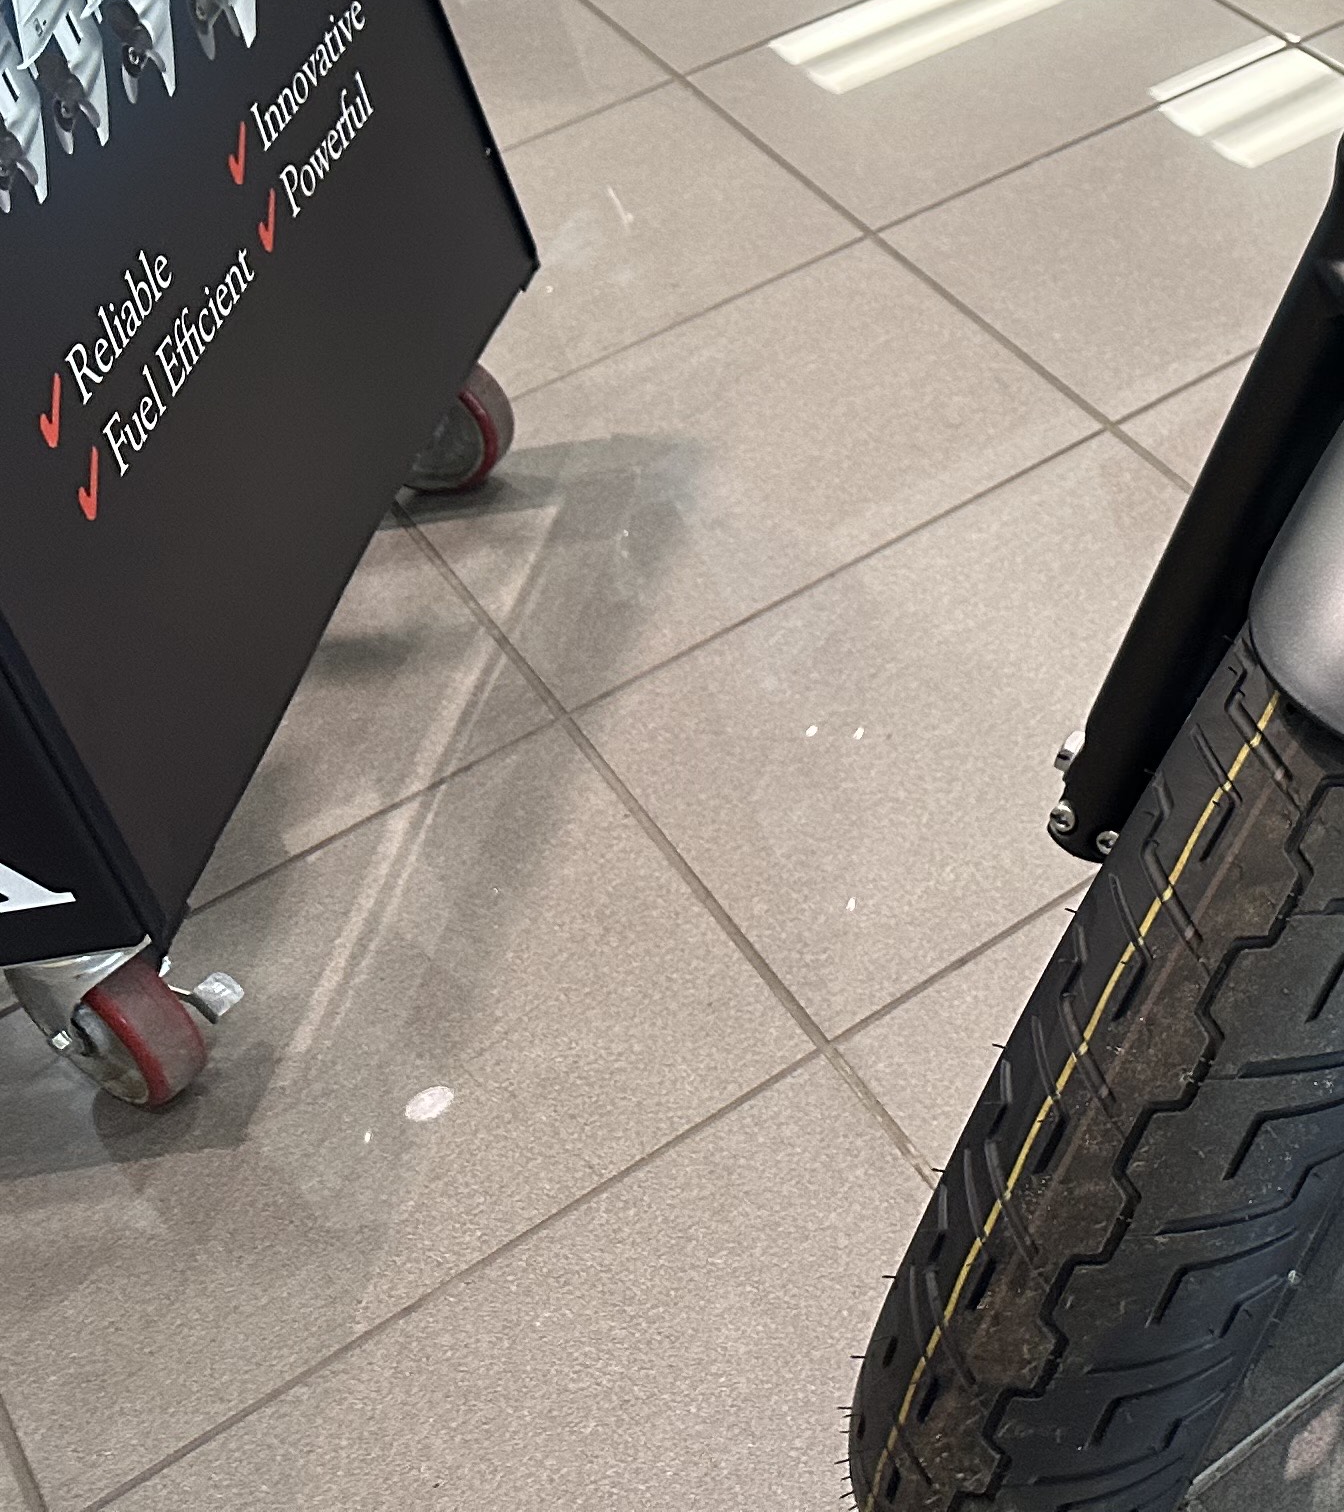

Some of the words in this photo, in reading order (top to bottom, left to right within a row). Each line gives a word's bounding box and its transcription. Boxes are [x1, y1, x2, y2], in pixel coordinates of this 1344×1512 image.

[250, 0, 366, 152] Innovative
[279, 71, 375, 218] Powerful
[64, 249, 173, 406] Reliable
[102, 363, 167, 477] Fuel
[155, 248, 255, 397] Efficient
